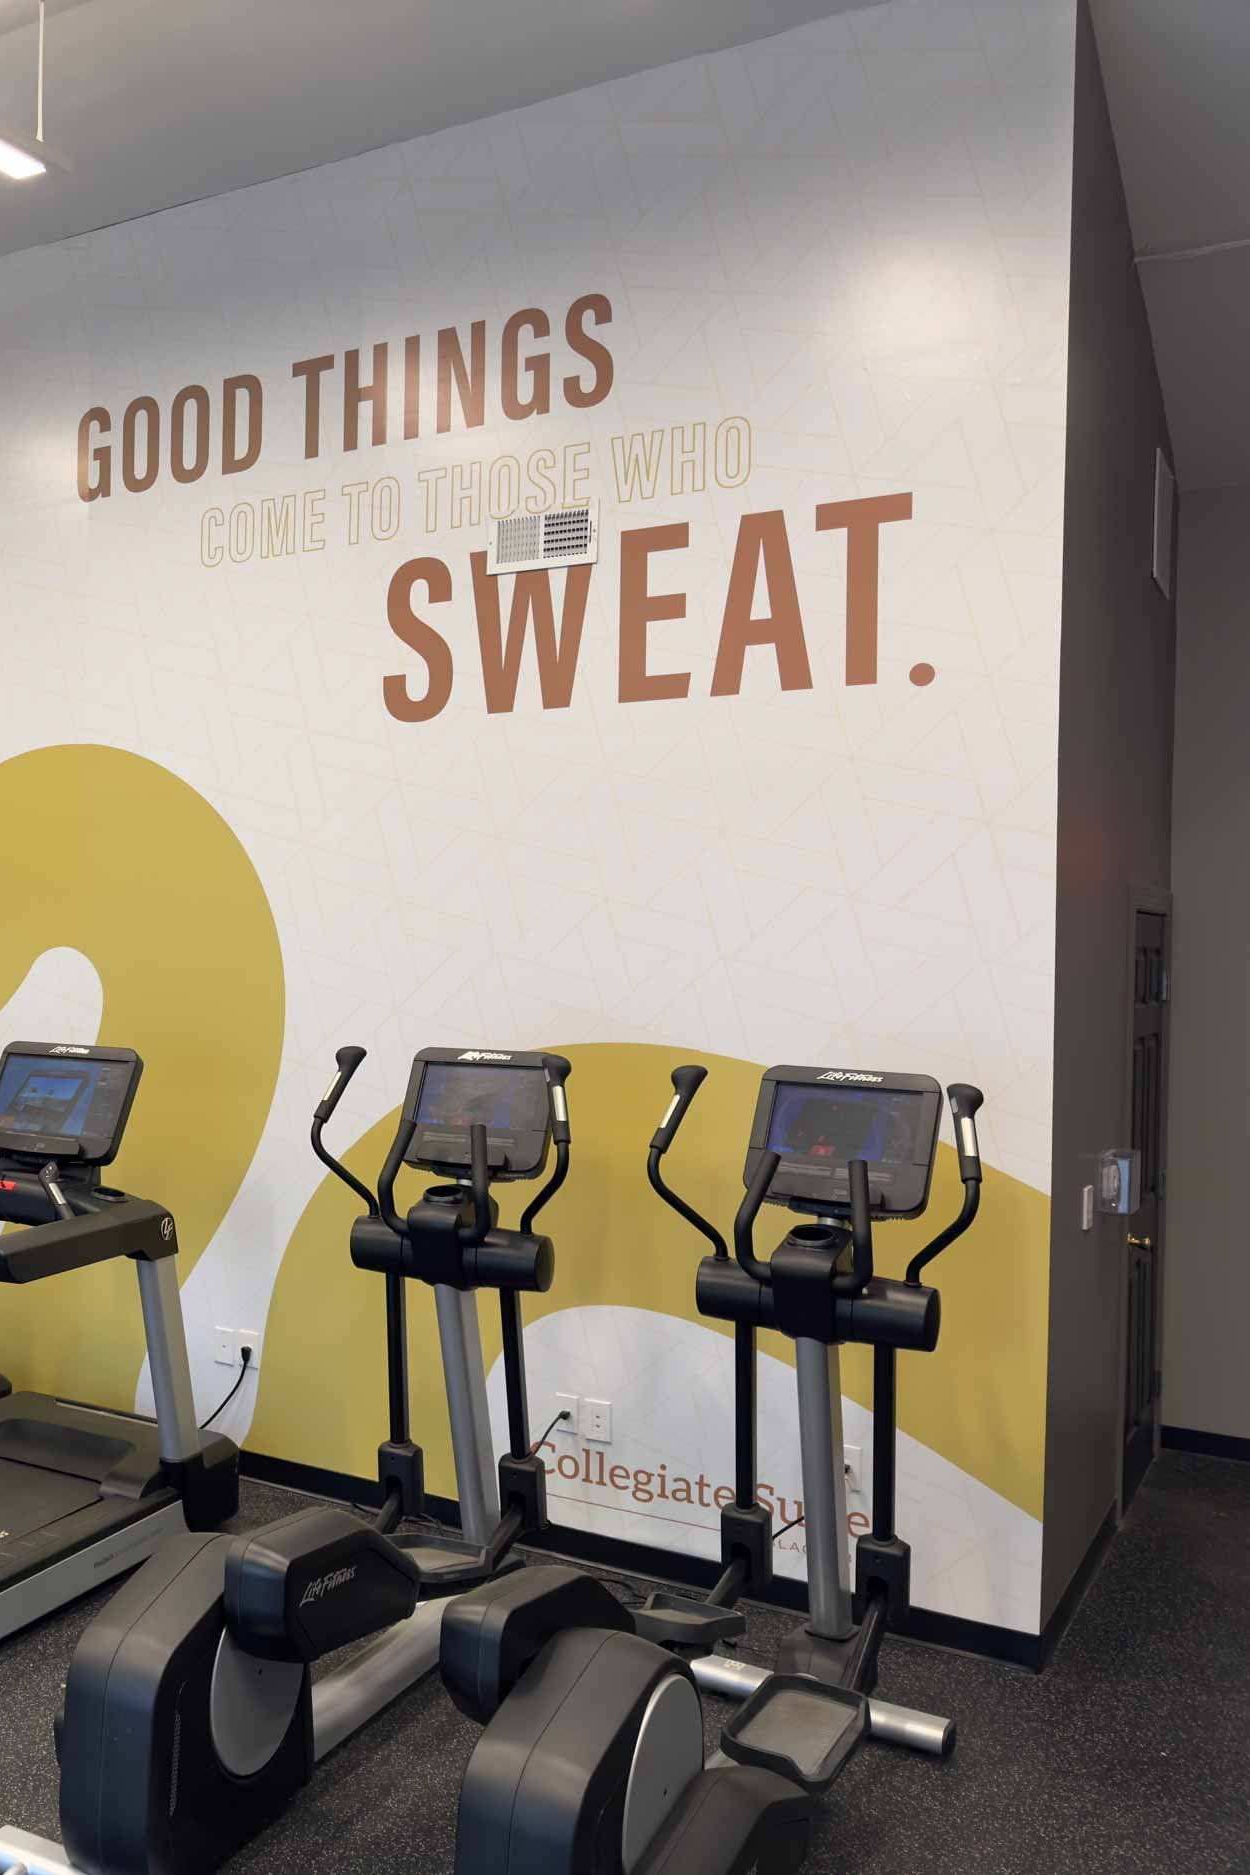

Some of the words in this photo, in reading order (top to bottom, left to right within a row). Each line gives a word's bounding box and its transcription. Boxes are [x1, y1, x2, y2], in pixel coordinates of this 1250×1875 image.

[77, 373, 263, 502] GOOD
[293, 293, 615, 460] THINGS
[200, 488, 326, 568] COME
[342, 476, 402, 545] TO
[418, 441, 592, 533] THOSE
[612, 415, 753, 503] WHO
[382, 491, 937, 724] SWEAT.
[530, 1440, 736, 1511] Collegiate
